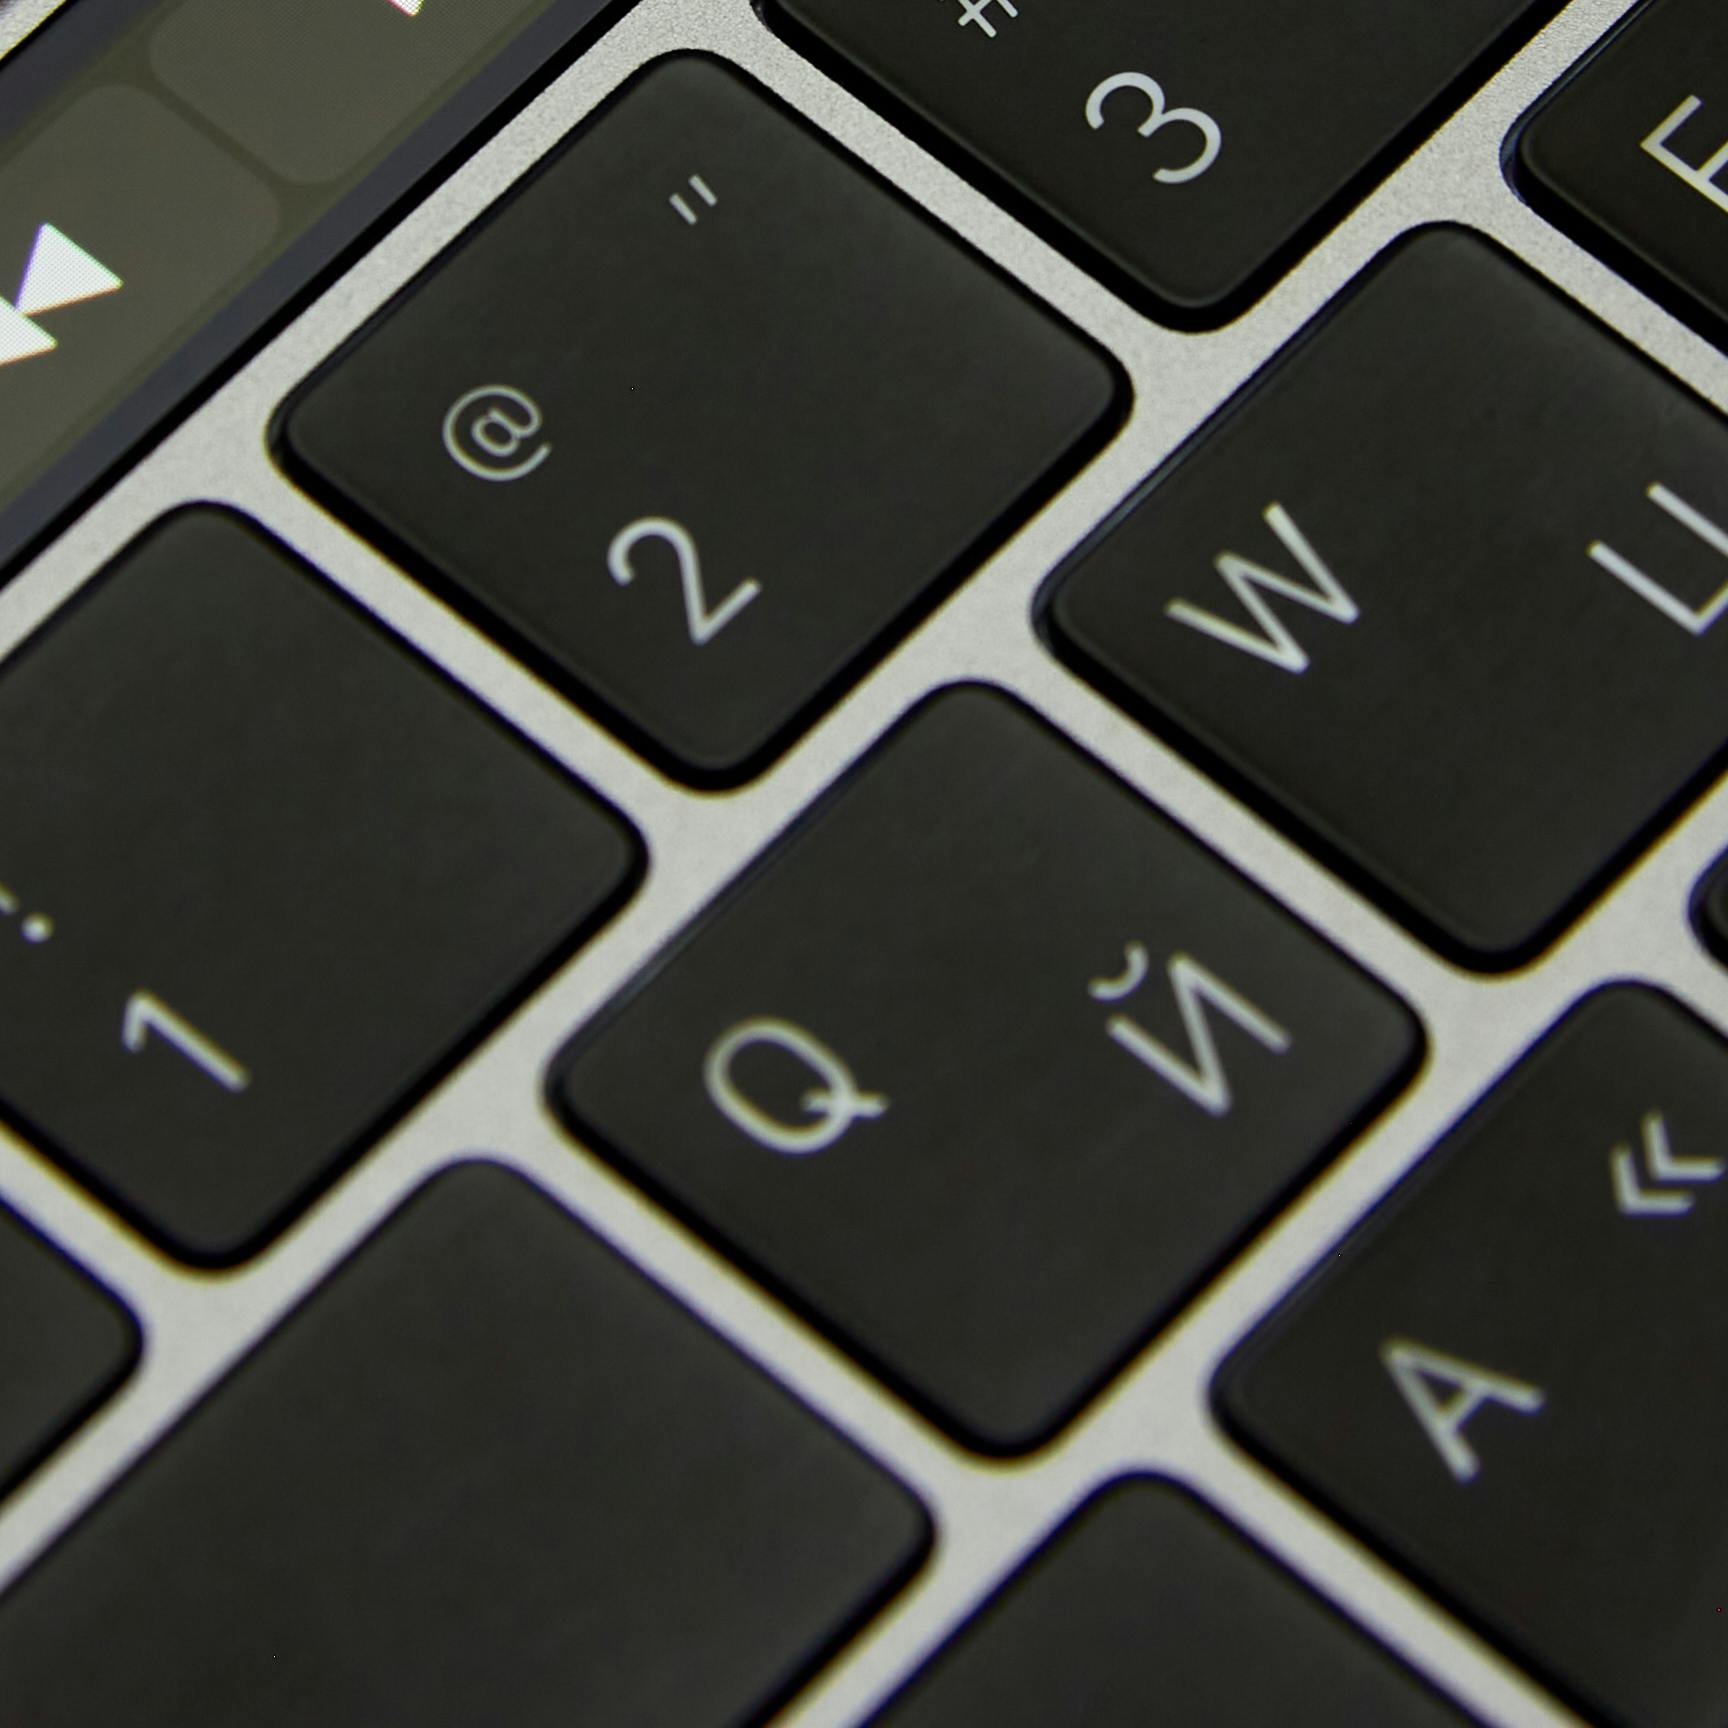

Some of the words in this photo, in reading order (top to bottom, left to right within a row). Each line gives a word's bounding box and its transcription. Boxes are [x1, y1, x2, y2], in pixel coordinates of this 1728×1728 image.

[1085, 71, 1222, 184] 3
[442, 384, 550, 482] @
[607, 517, 759, 644] 2
[1168, 503, 1359, 674] W
[122, 993, 244, 1090] 1
[706, 1020, 885, 1155] Q
[1091, 946, 1288, 1115] Й
[1385, 1343, 1543, 1482] A
